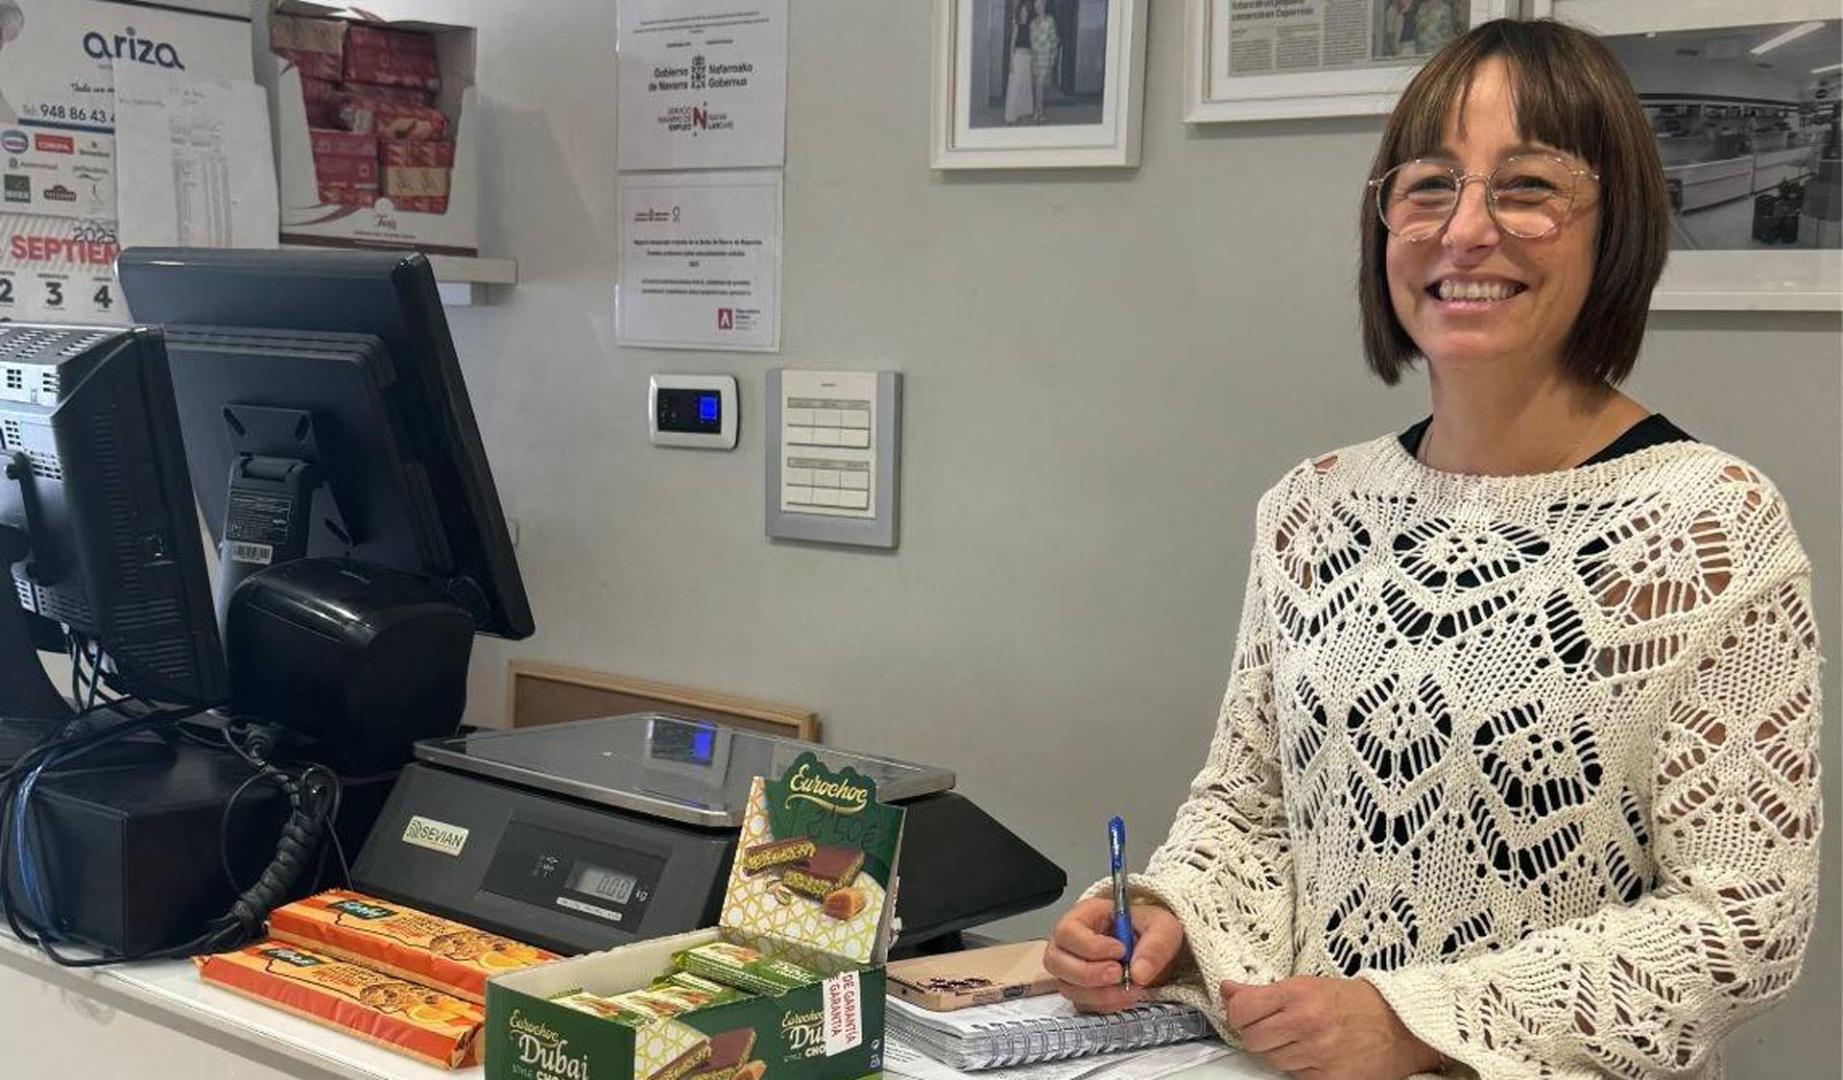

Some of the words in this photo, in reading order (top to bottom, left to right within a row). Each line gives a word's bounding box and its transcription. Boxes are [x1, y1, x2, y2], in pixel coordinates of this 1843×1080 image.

[83, 26, 186, 71] ariza
[654, 67, 688, 78] Gobierno
[708, 62, 753, 75] Nafarroako
[648, 83, 657, 92] de
[658, 80, 688, 91] Navarra
[40, 103, 66, 119] 948
[69, 106, 87, 121] 86
[90, 109, 107, 123] 43
[73, 226, 117, 245] 2025
[0, 278, 14, 303] 2
[45, 282, 63, 306] 3
[93, 285, 113, 309] 4
[789, 763, 869, 803] Eurochoc
[420, 824, 464, 849] SEVIAN
[509, 1009, 559, 1043] Eurochoc
[782, 1010, 824, 1027] Eurocho
[790, 1025, 825, 1050] Du
[518, 1034, 590, 1080] Dubai
[805, 1044, 826, 1058] CHO
